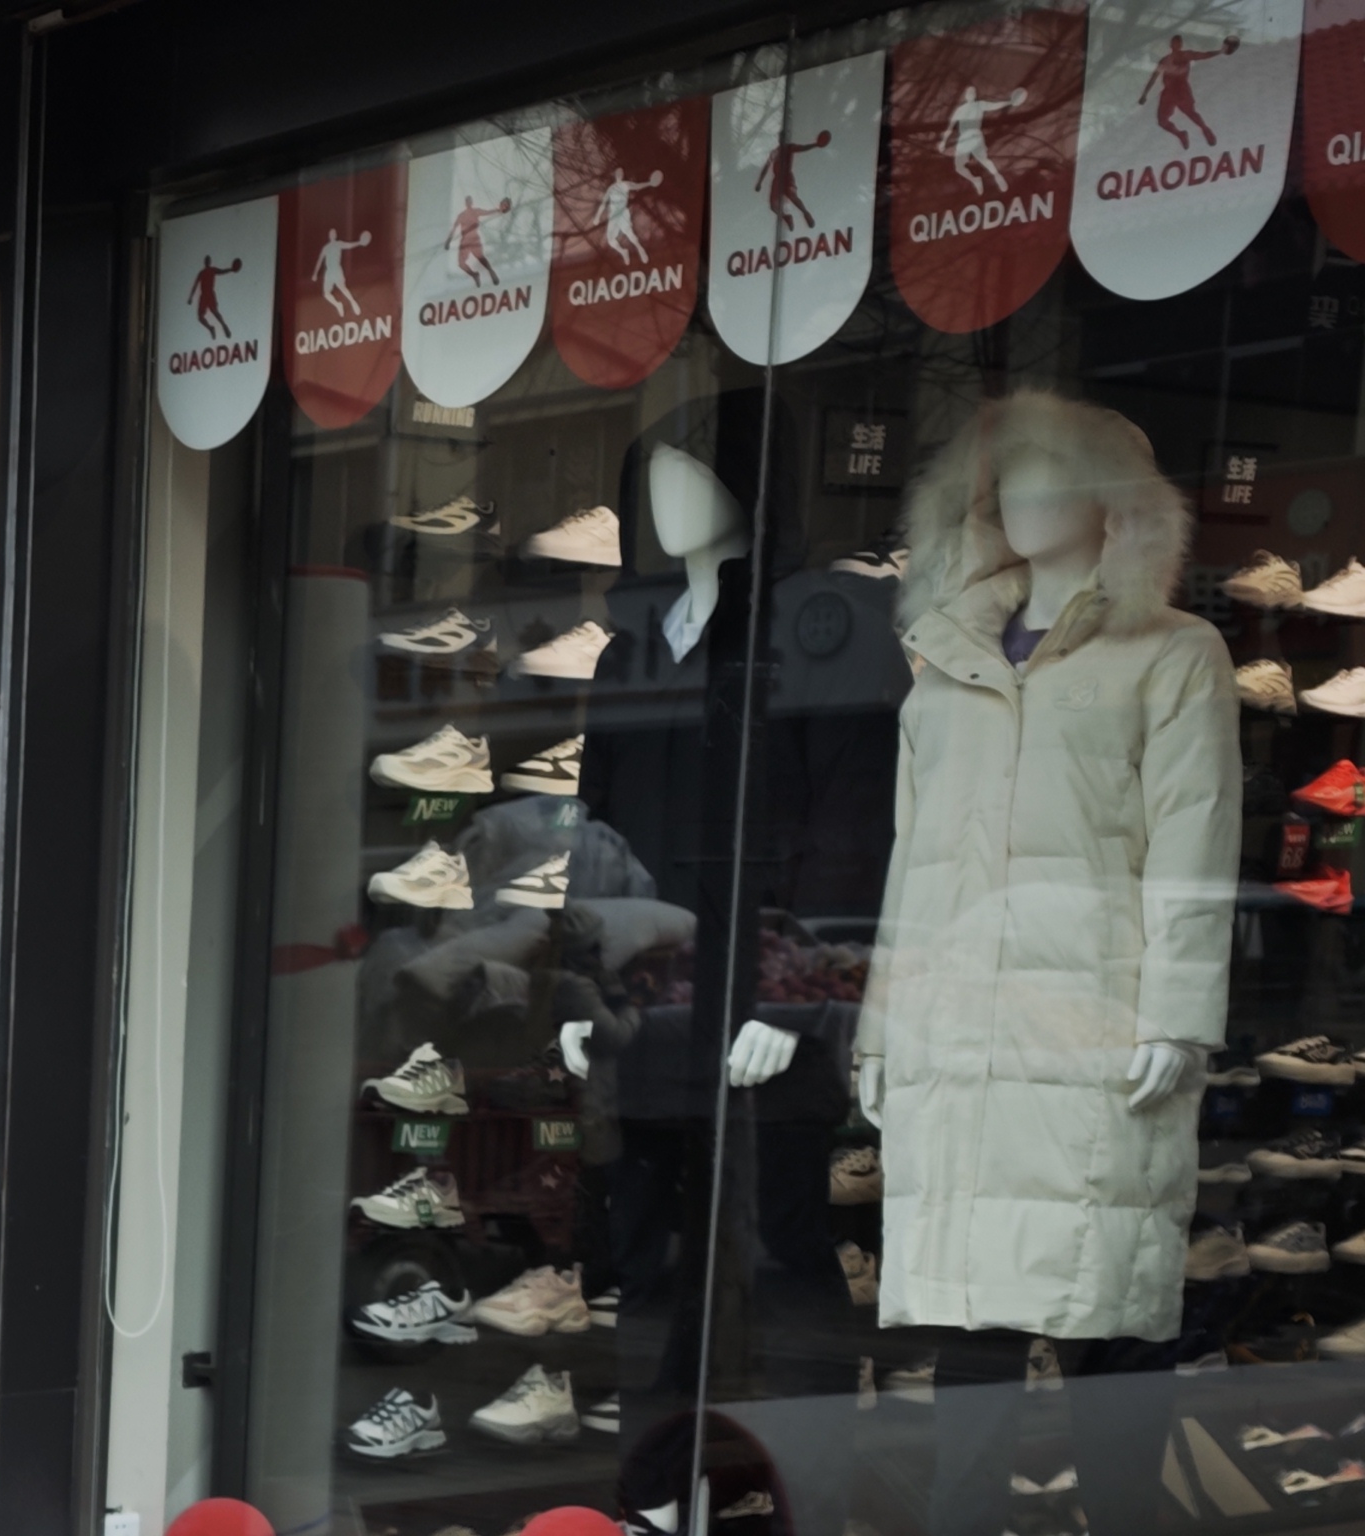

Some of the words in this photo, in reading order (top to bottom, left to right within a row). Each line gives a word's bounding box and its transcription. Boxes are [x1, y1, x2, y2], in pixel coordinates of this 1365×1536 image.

[1327, 132, 1365, 166] QI
[1097, 145, 1265, 201] QIAODAN
[909, 191, 1053, 242] QIAODAN
[727, 228, 853, 277] QIAODAN
[569, 264, 682, 306] QIAODAN
[419, 285, 531, 326] QIAODAN
[295, 314, 392, 354] QIAODAN
[169, 339, 258, 375] QIAODAN
[851, 423, 886, 450] 生活
[849, 453, 882, 475] LIFE
[1227, 456, 1257, 481] 生活
[1224, 485, 1253, 504] LIFE
[412, 798, 459, 821] NEW
[400, 1122, 440, 1148] NEW
